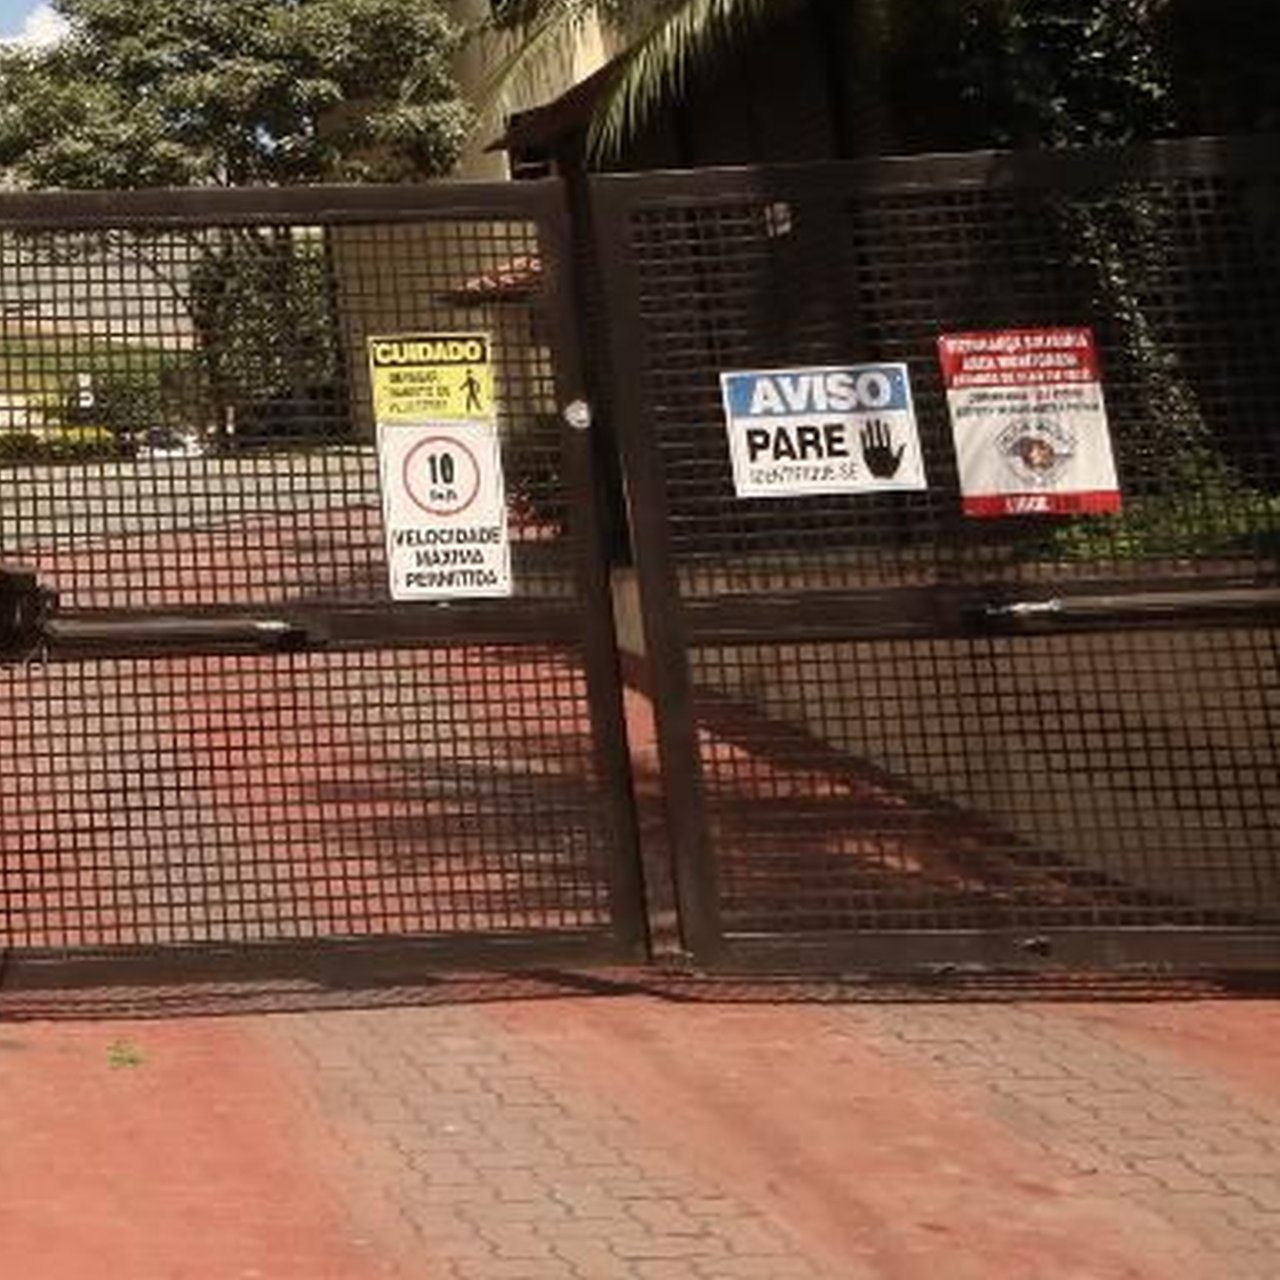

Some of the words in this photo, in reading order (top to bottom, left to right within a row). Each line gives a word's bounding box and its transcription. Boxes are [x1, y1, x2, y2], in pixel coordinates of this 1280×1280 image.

[376, 341, 482, 364] CUIDADO
[750, 372, 891, 414] AVISO
[746, 423, 850, 463] PARE
[427, 453, 454, 484] 10
[393, 527, 501, 548] VELOCIDADE
[406, 569, 498, 587] PERMITIDA
